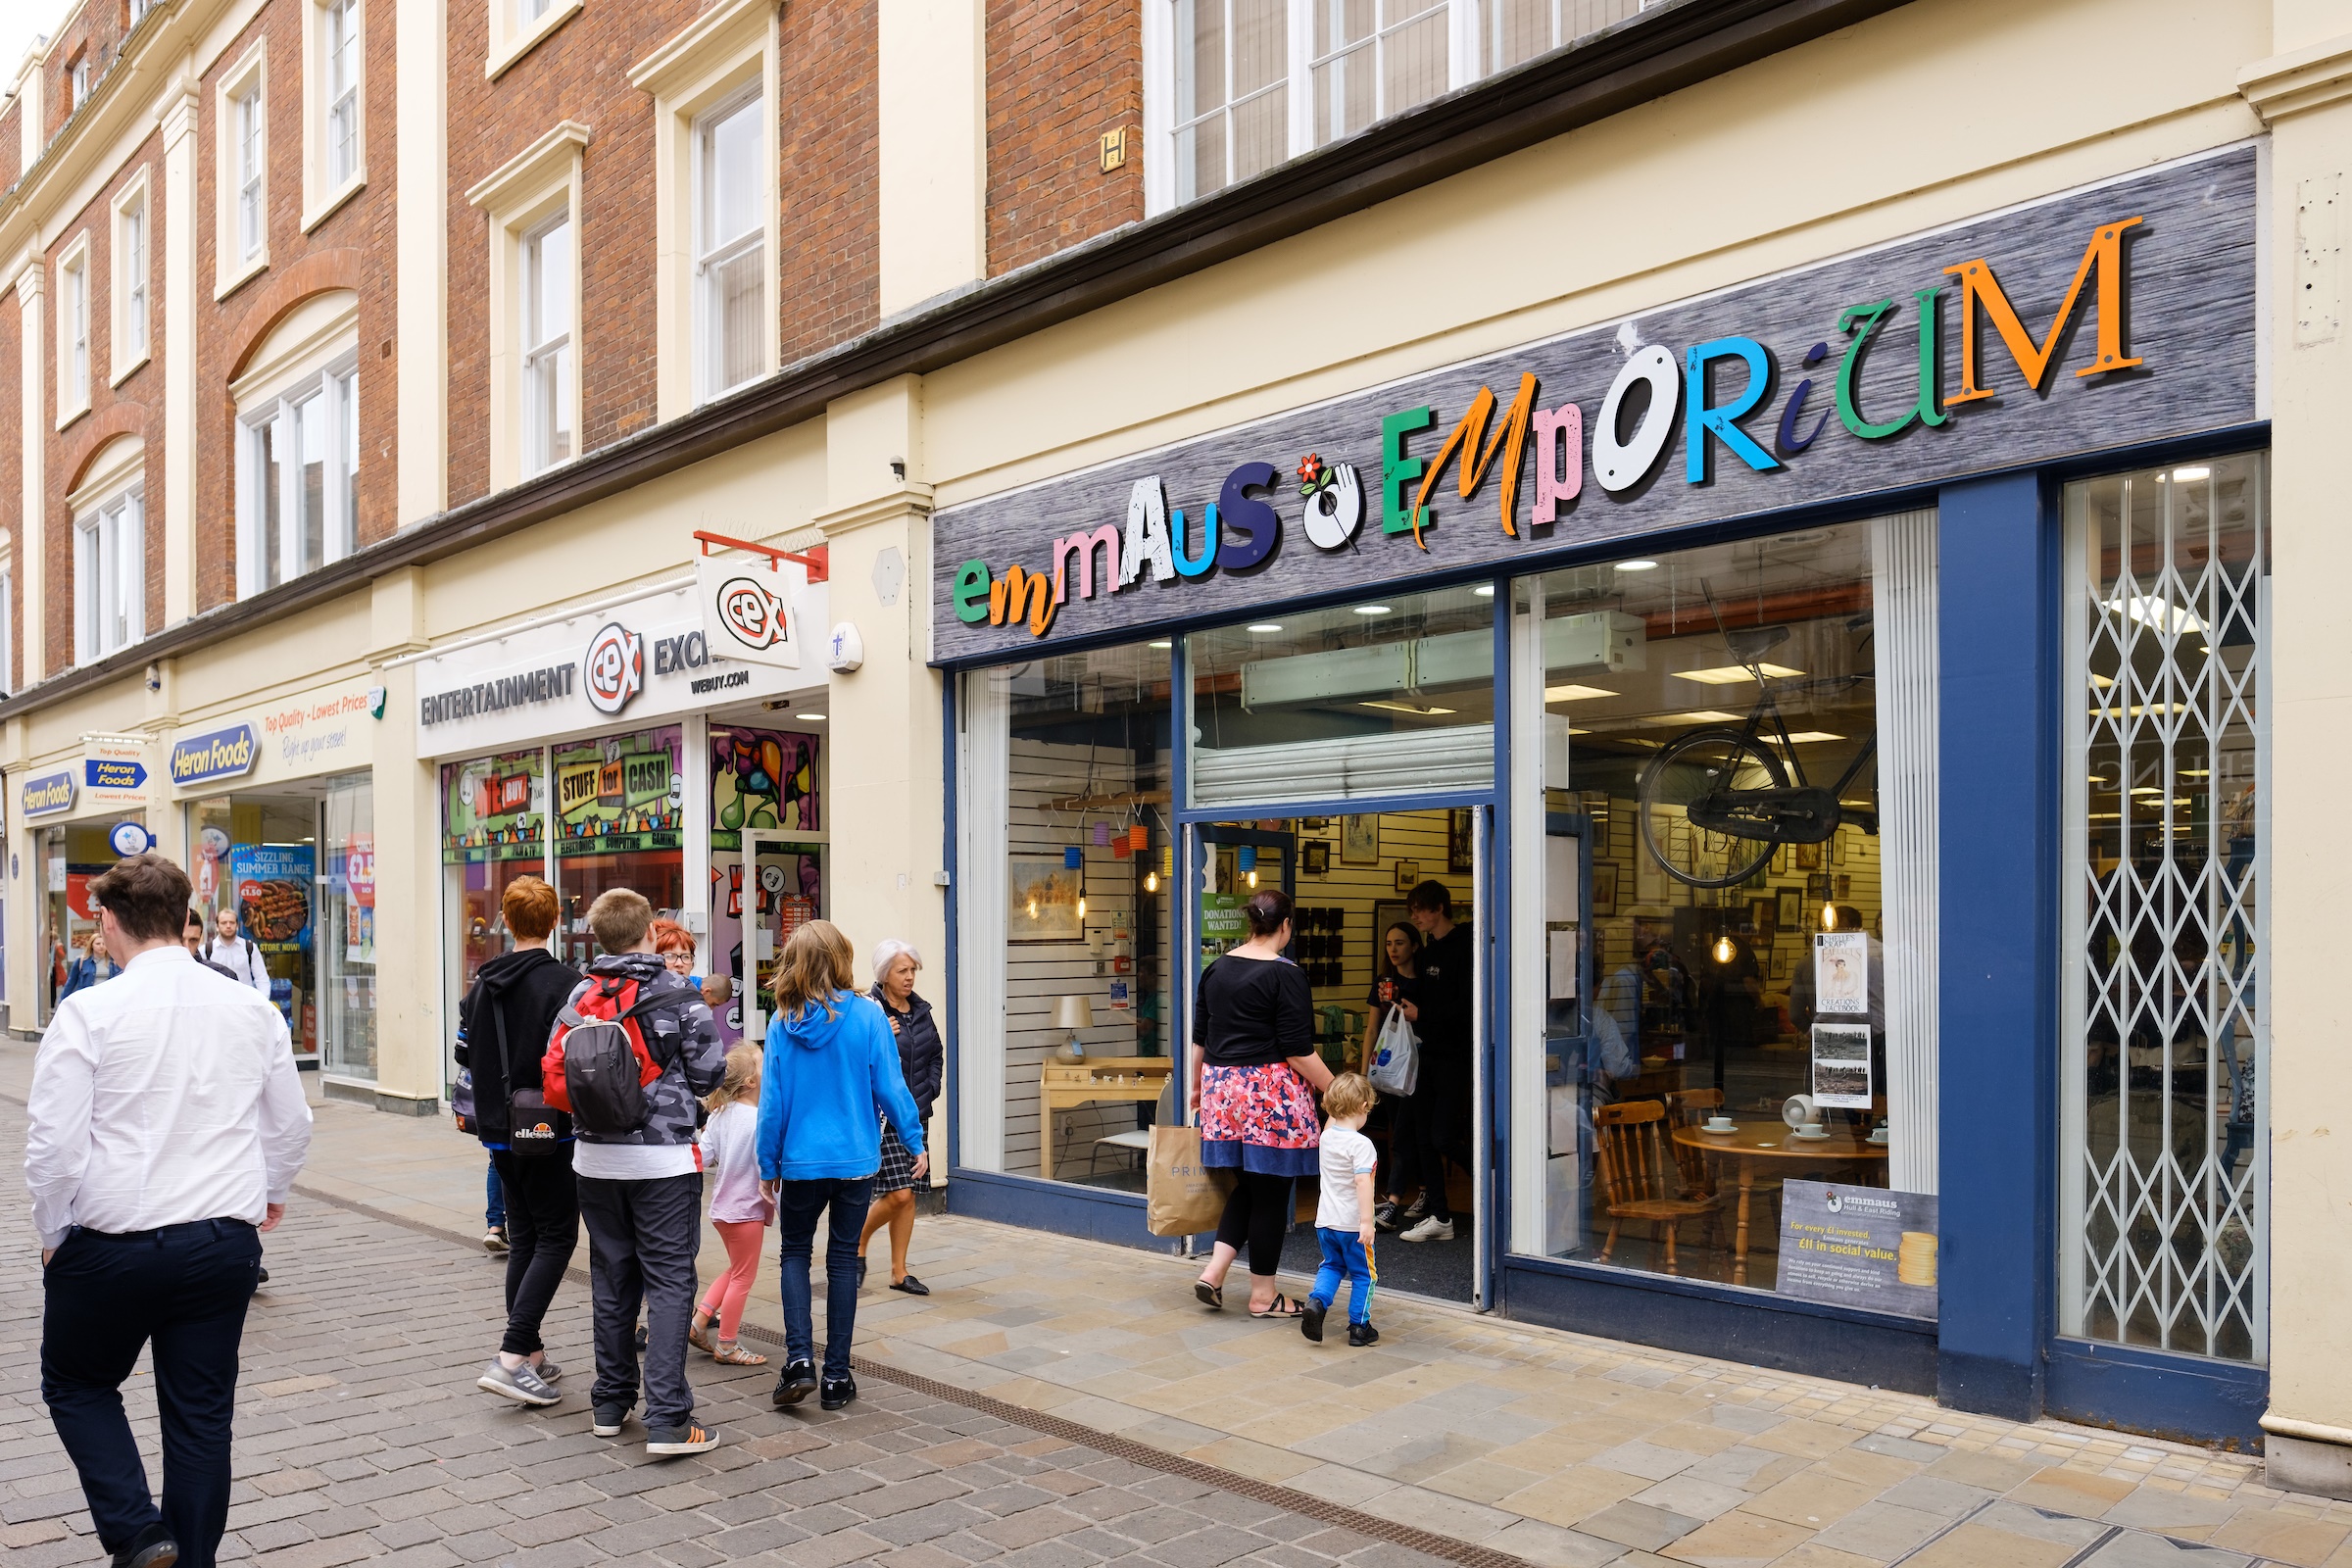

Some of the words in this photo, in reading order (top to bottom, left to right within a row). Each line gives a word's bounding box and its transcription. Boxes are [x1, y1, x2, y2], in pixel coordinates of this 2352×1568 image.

[1110, 136, 1116, 145] 6
[1109, 154, 1115, 163] 6
[691, 670, 749, 695] WEBUY.COM
[420, 662, 575, 726] ENTERTAINMENT
[265, 716, 277, 735] Top
[278, 709, 305, 733] Quality
[312, 701, 340, 721] Lowest
[342, 694, 368, 714] Prices
[99, 748, 113, 757] Top
[114, 749, 140, 758] Quality
[173, 749, 210, 778] Heron
[210, 730, 250, 771] Foods
[282, 735, 300, 766] Right
[310, 736, 325, 762] your
[97, 762, 136, 774] Heron
[98, 774, 135, 786] Foods
[563, 769, 595, 802] STUFF
[603, 769, 618, 793] for
[628, 760, 665, 793] CASH
[24, 787, 46, 810] Heron
[46, 776, 70, 807] Foods
[506, 779, 523, 803] BUY
[561, 839, 596, 854] ELECTRONICS
[606, 835, 640, 850] COMPUTING
[652, 832, 676, 846] GAMING
[255, 851, 293, 863] SIZZLING
[237, 862, 278, 874] SUMMER
[281, 863, 311, 875] RANGE
[1203, 909, 1246, 920] DONATIONS
[1206, 920, 1242, 930] WANTED!
[1824, 934, 1856, 943] CHELLE'S
[514, 1129, 555, 1139] ellesse
[1843, 1196, 1897, 1208] emmaus
[1880, 1208, 1901, 1218] Riding
[1804, 1225, 1826, 1235] every
[1837, 1228, 1871, 1240] invested,
[1823, 1235, 1843, 1244] Emmaus
[1844, 1238, 1869, 1247] generates
[1799, 1238, 1814, 1250] £11
[1816, 1241, 1827, 1251] in
[1830, 1244, 1861, 1256] social
[1865, 1249, 1897, 1261] value.
